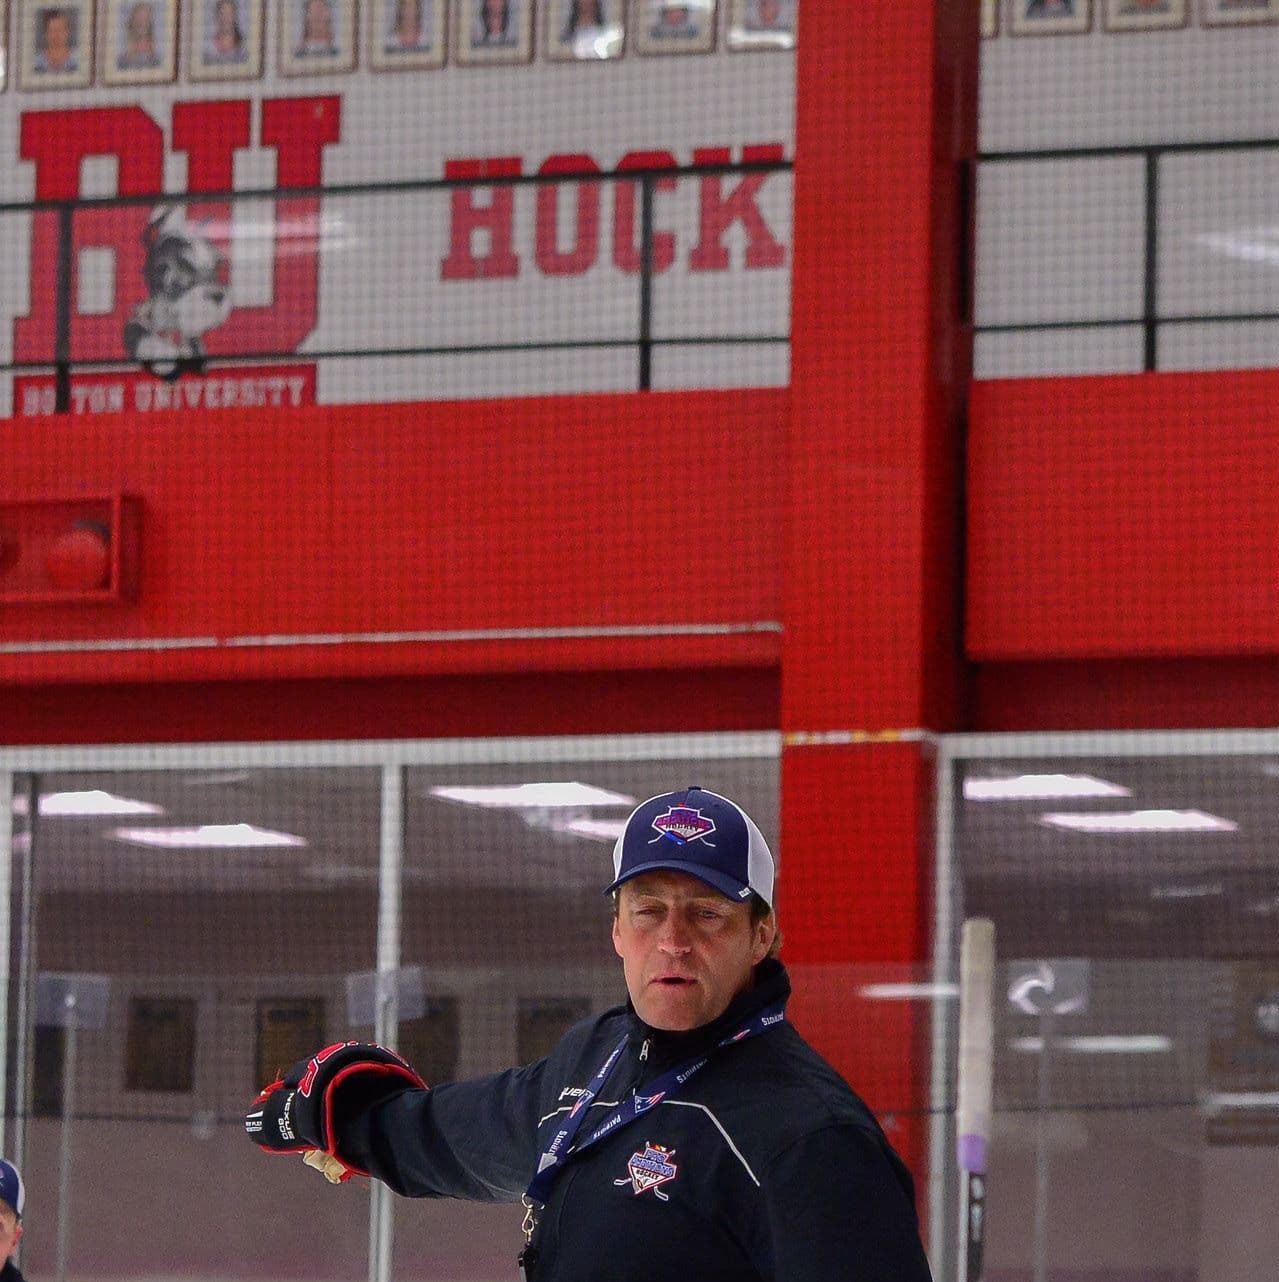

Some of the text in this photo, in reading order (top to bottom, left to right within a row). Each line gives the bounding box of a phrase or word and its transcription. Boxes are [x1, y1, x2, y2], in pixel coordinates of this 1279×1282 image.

[12, 95, 342, 362] BU
[23, 376, 305, 417] BOTON UNIVERSITY
[283, 1092, 296, 1140] NEXUS
